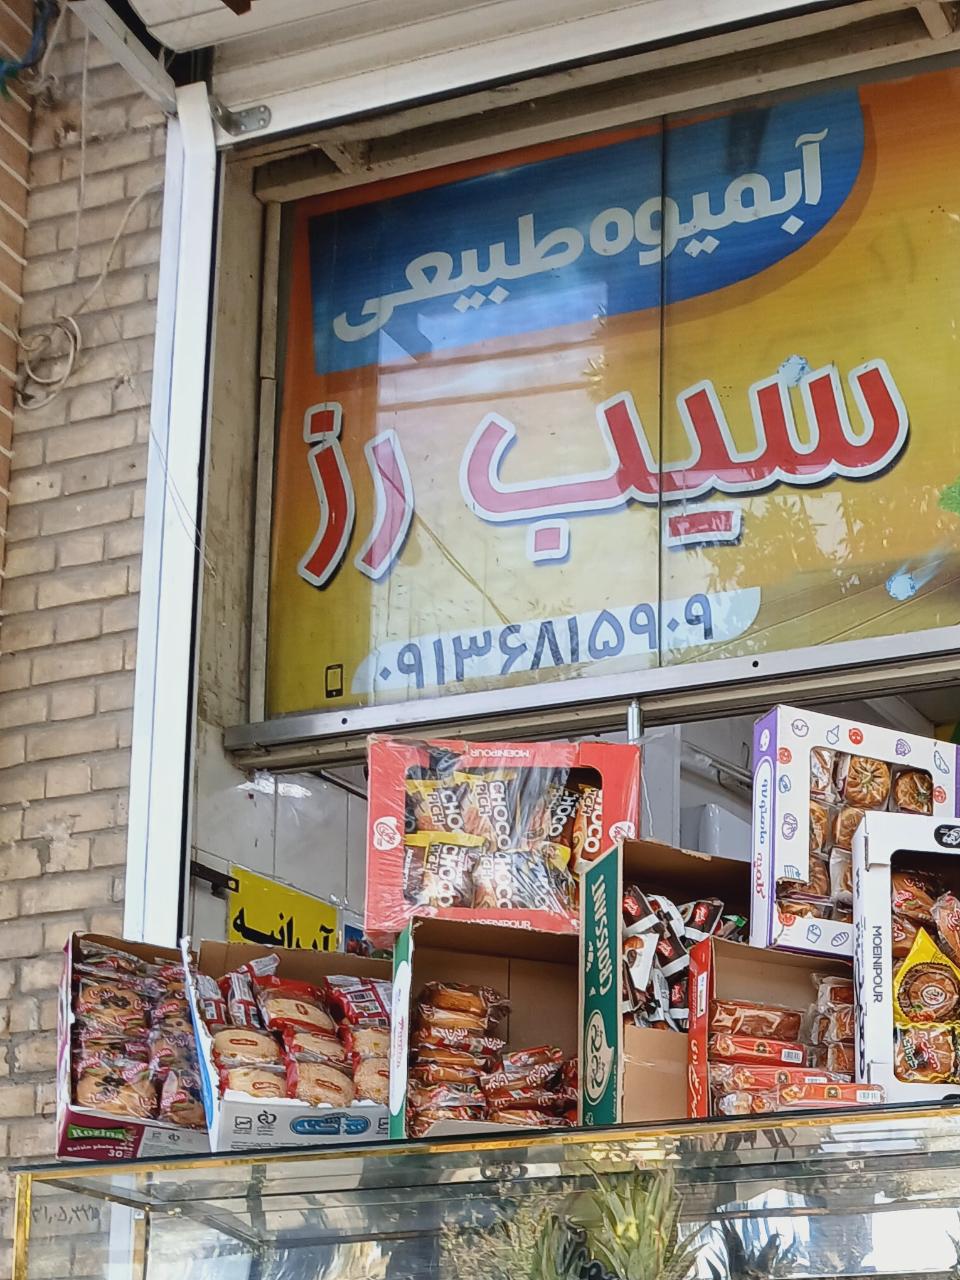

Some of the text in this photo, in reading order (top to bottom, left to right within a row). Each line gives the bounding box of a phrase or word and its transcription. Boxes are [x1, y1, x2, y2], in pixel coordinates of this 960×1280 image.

[331, 128, 828, 343] آبمیوه طبیعی
[300, 355, 911, 586] سیب رز
[380, 593, 713, 690] ۰۹۱۳۶۸۱۵۹۰۹
[475, 783, 491, 816] PICH
[489, 781, 512, 850] CHOCO
[592, 875, 612, 995] CROISSANT
[71, 1128, 124, 1139] Rozina
